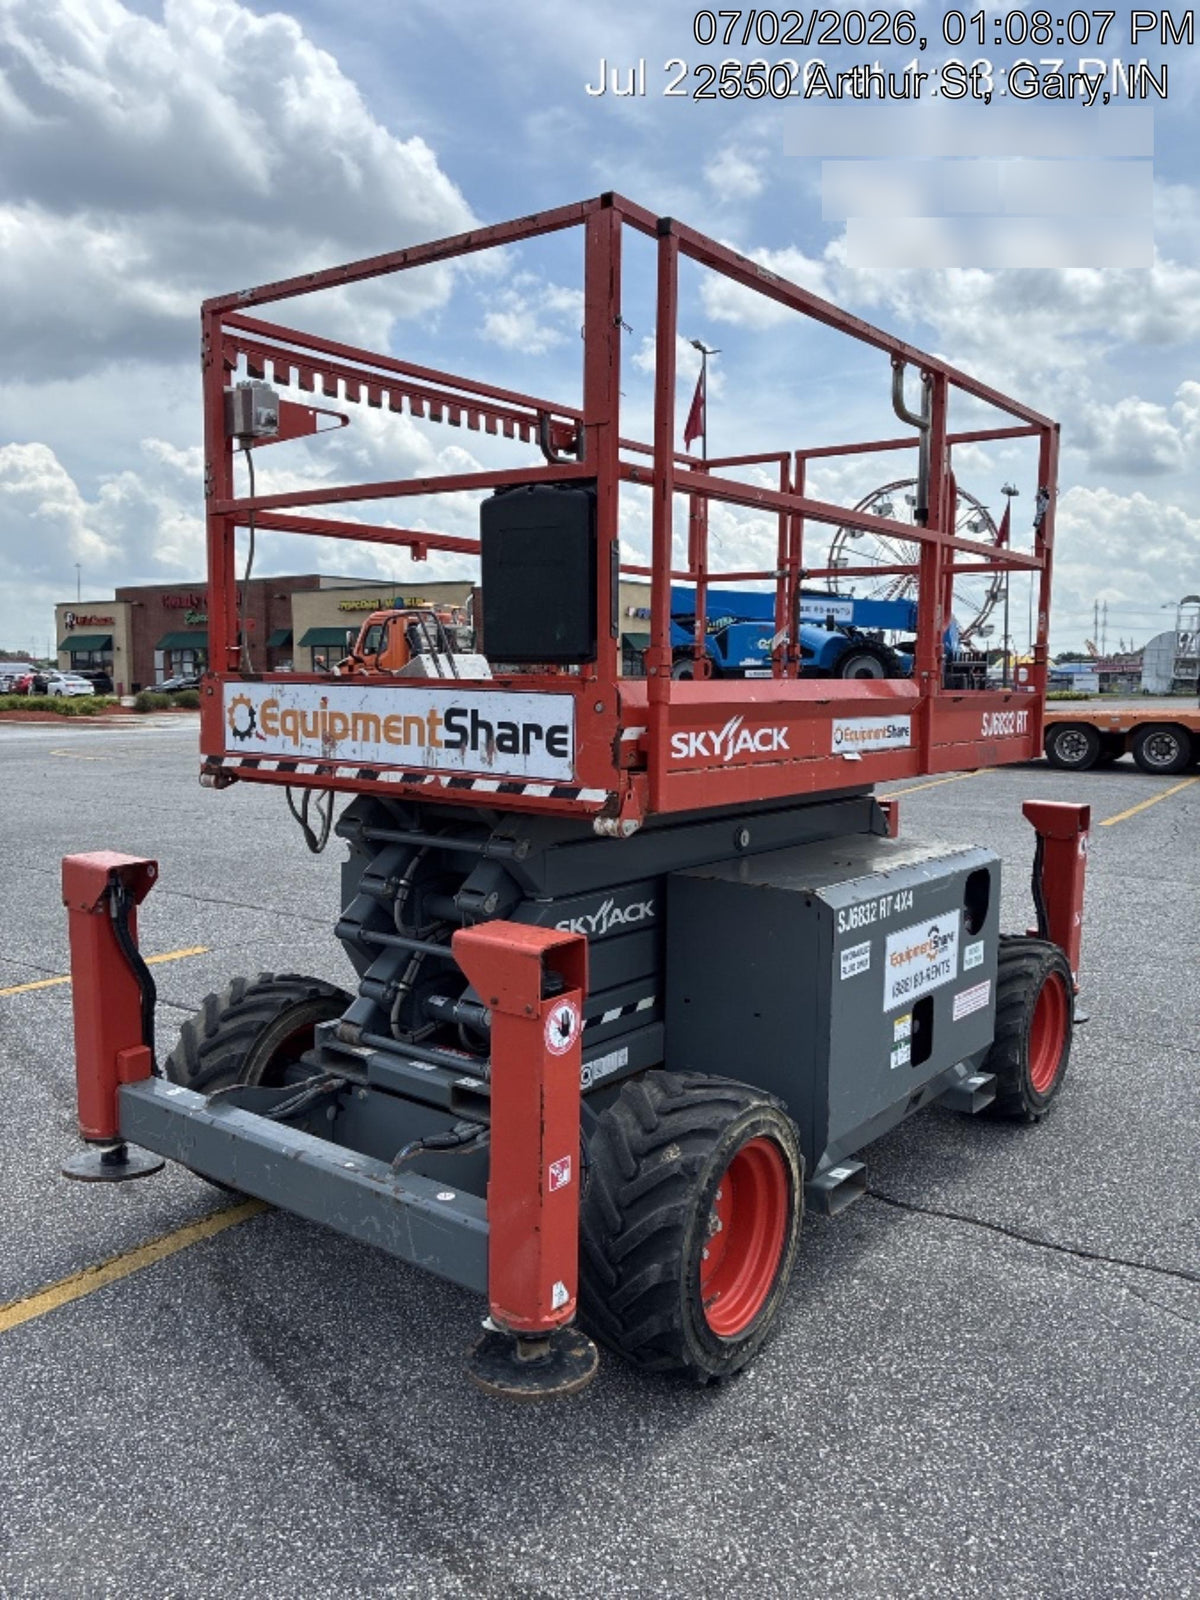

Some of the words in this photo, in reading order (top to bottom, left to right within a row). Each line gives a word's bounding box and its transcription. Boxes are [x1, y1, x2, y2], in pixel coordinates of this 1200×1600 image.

[259, 699, 569, 759] EquipmentShare
[671, 714, 790, 761] SKYJACK
[844, 725, 910, 743] EquipmentShare
[555, 898, 655, 935] SKYJACK
[837, 901, 877, 934] SJ6832
[893, 890, 913, 913] 4X4
